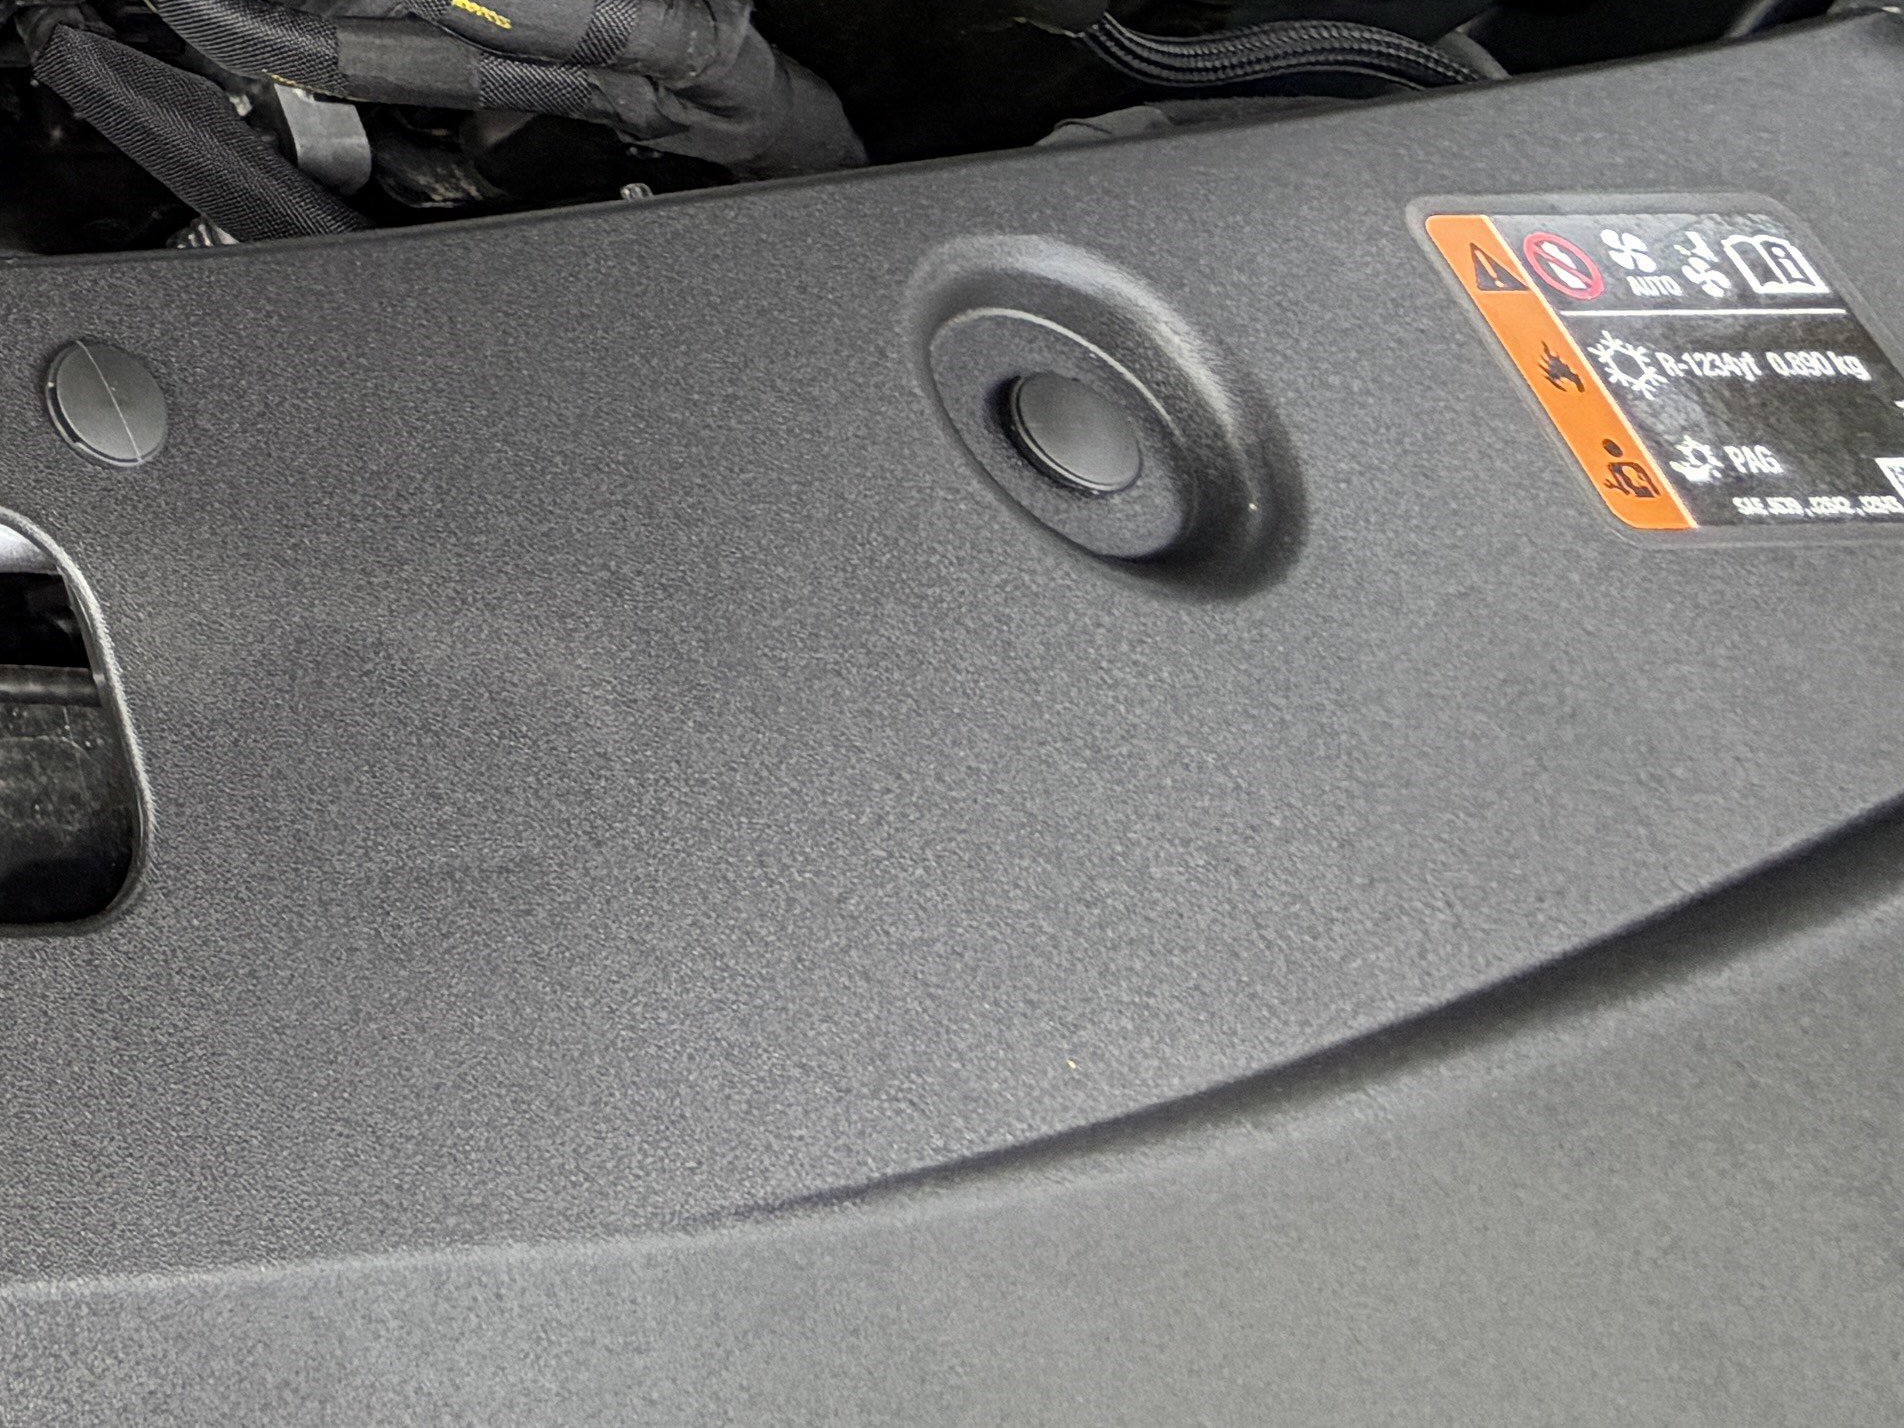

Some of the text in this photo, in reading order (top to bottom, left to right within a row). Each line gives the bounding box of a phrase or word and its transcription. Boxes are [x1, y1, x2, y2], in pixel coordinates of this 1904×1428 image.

[1626, 276, 1683, 297] AUTO
[1655, 351, 1872, 382] R-1234yf 0.890 kg
[1723, 444, 1785, 474] PAG
